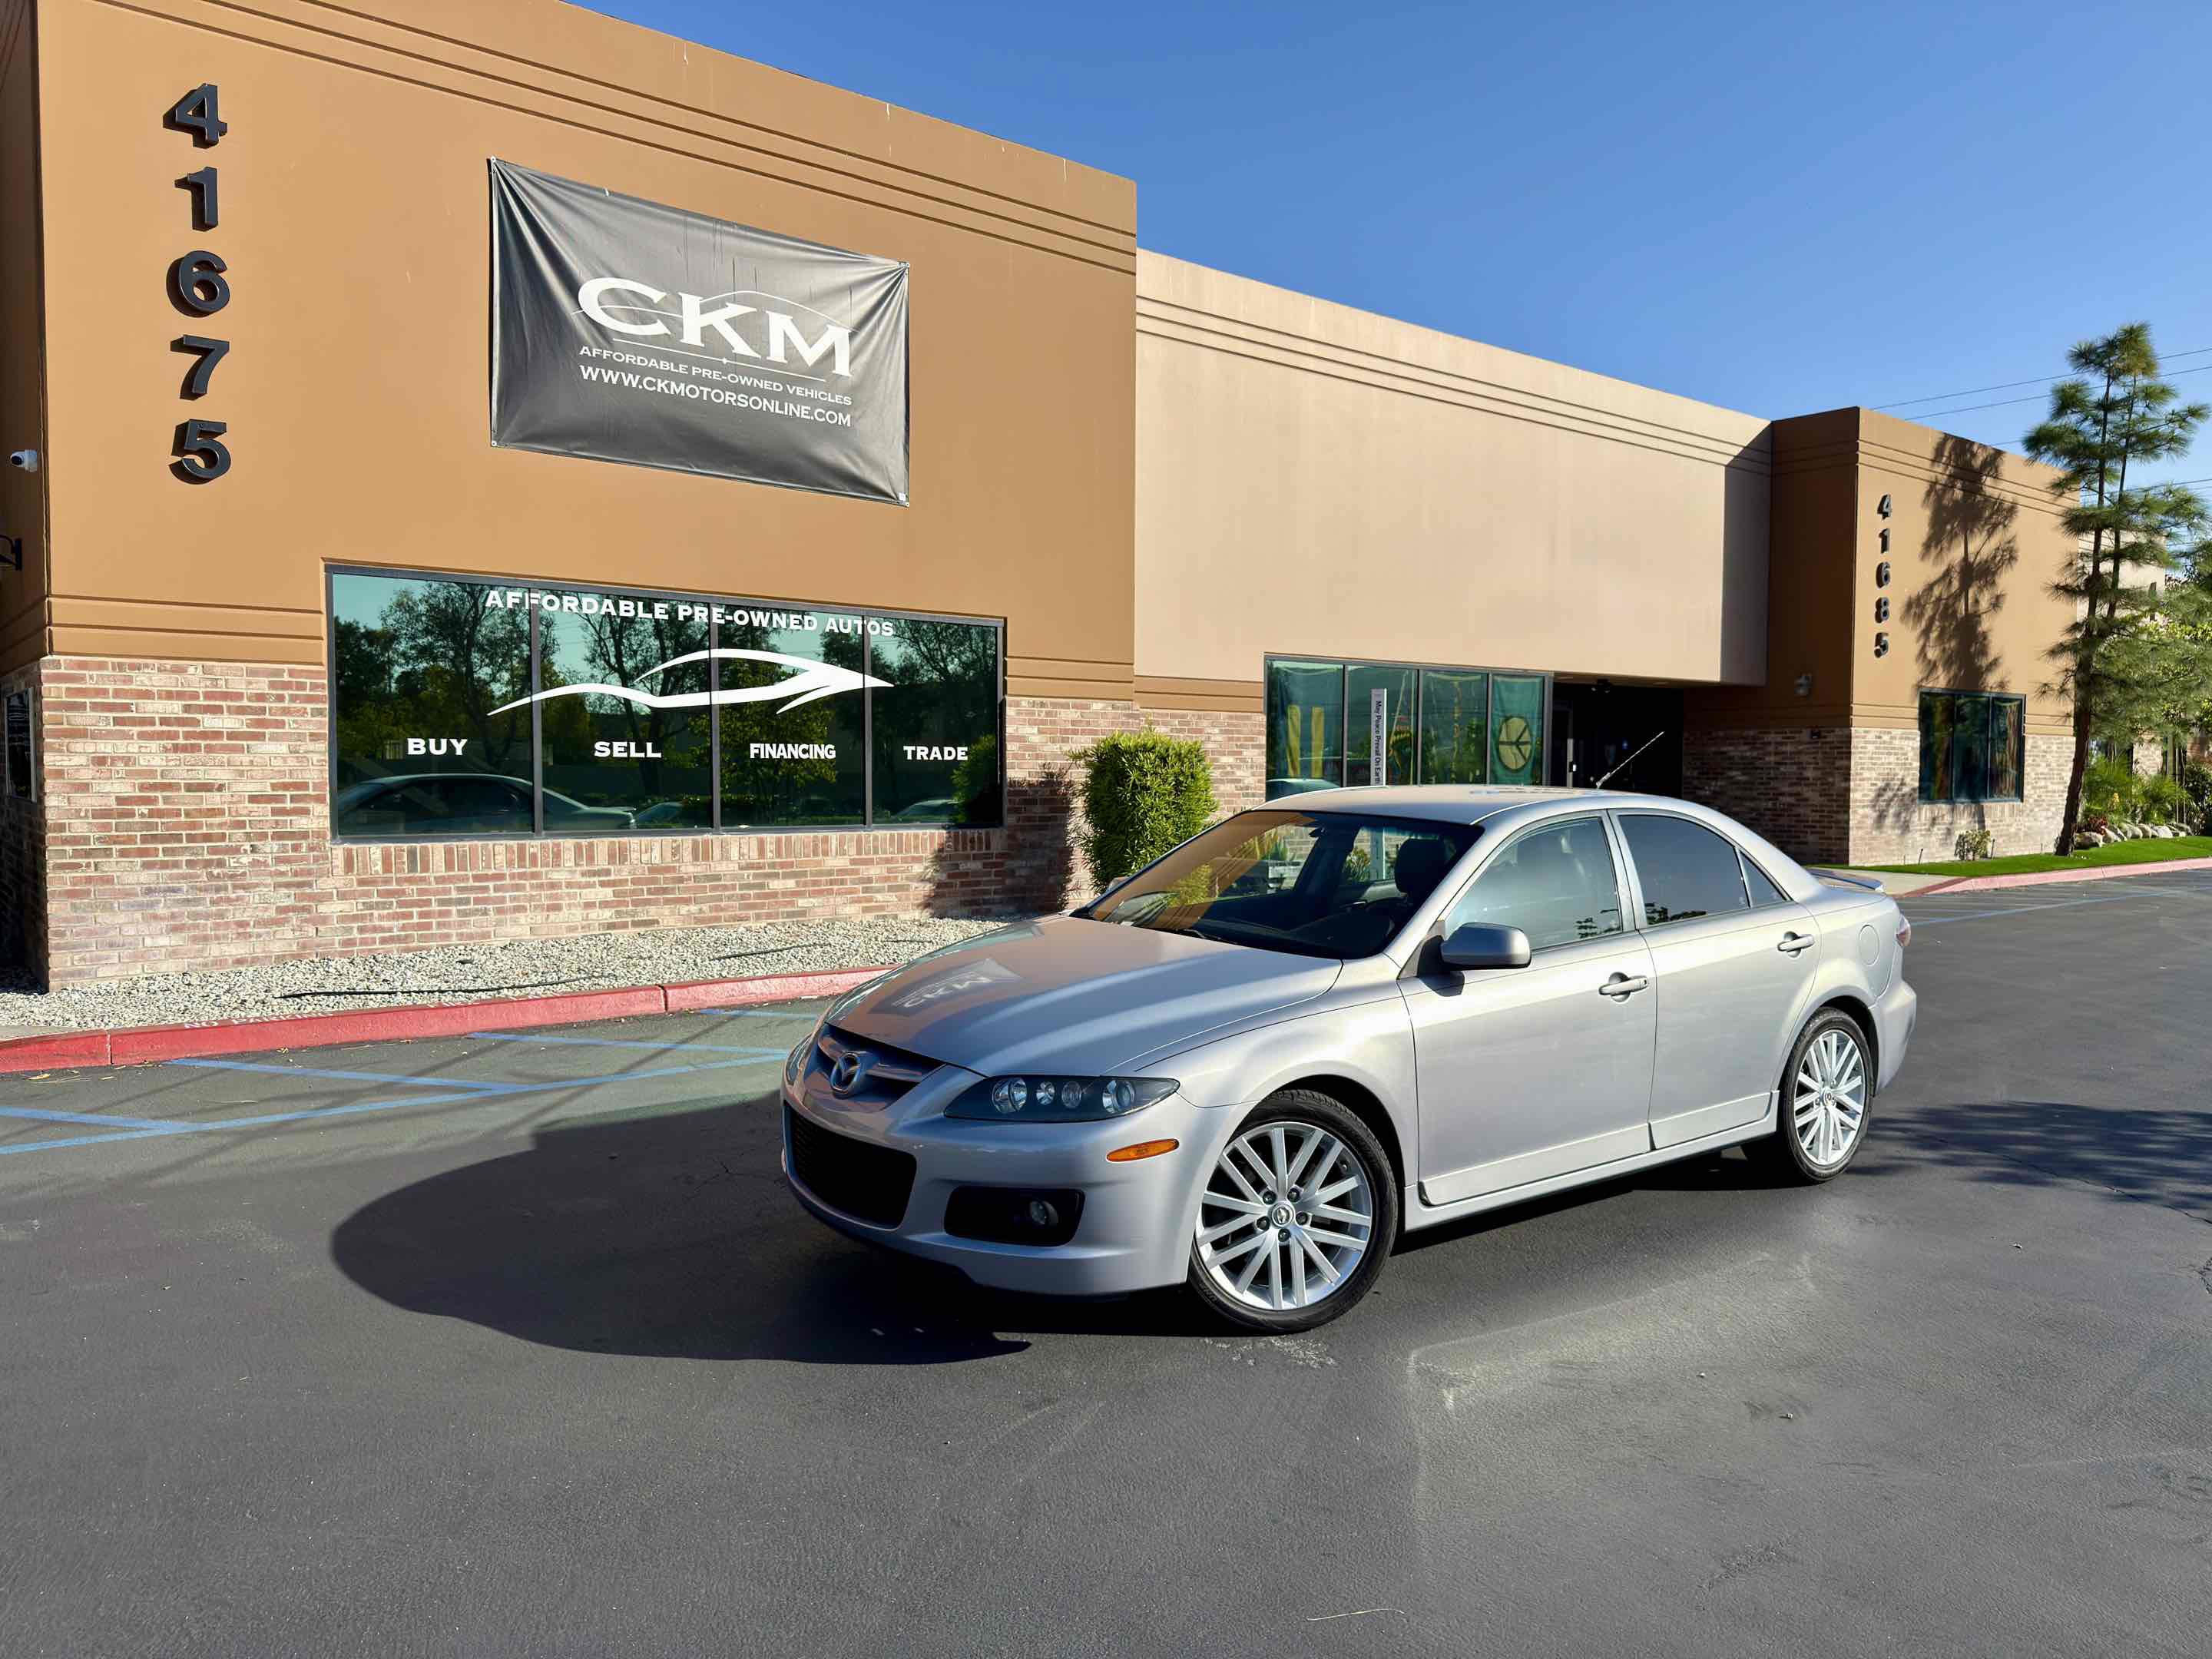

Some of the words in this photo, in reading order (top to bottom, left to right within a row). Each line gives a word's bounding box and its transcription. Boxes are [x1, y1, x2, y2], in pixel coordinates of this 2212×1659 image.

[164, 83, 231, 485] 41675
[578, 277, 853, 377] CKM
[579, 346, 689, 375] AFFORDABLE
[692, 366, 783, 392] PRE-OWNED
[786, 385, 853, 406] VEHICLES
[580, 365, 852, 427] WWW.CKMOTORSONLINE.COM
[1874, 494, 1892, 658] 41685
[485, 590, 669, 621] AFFORDABLE
[677, 604, 818, 631] PRE-OWNED
[825, 618, 894, 637] AUTOS
[406, 738, 468, 756] BUY
[594, 741, 662, 758] SELL
[750, 743, 836, 760] FINANCING
[902, 745, 969, 760] TRADE
[1375, 757, 1382, 767] On
